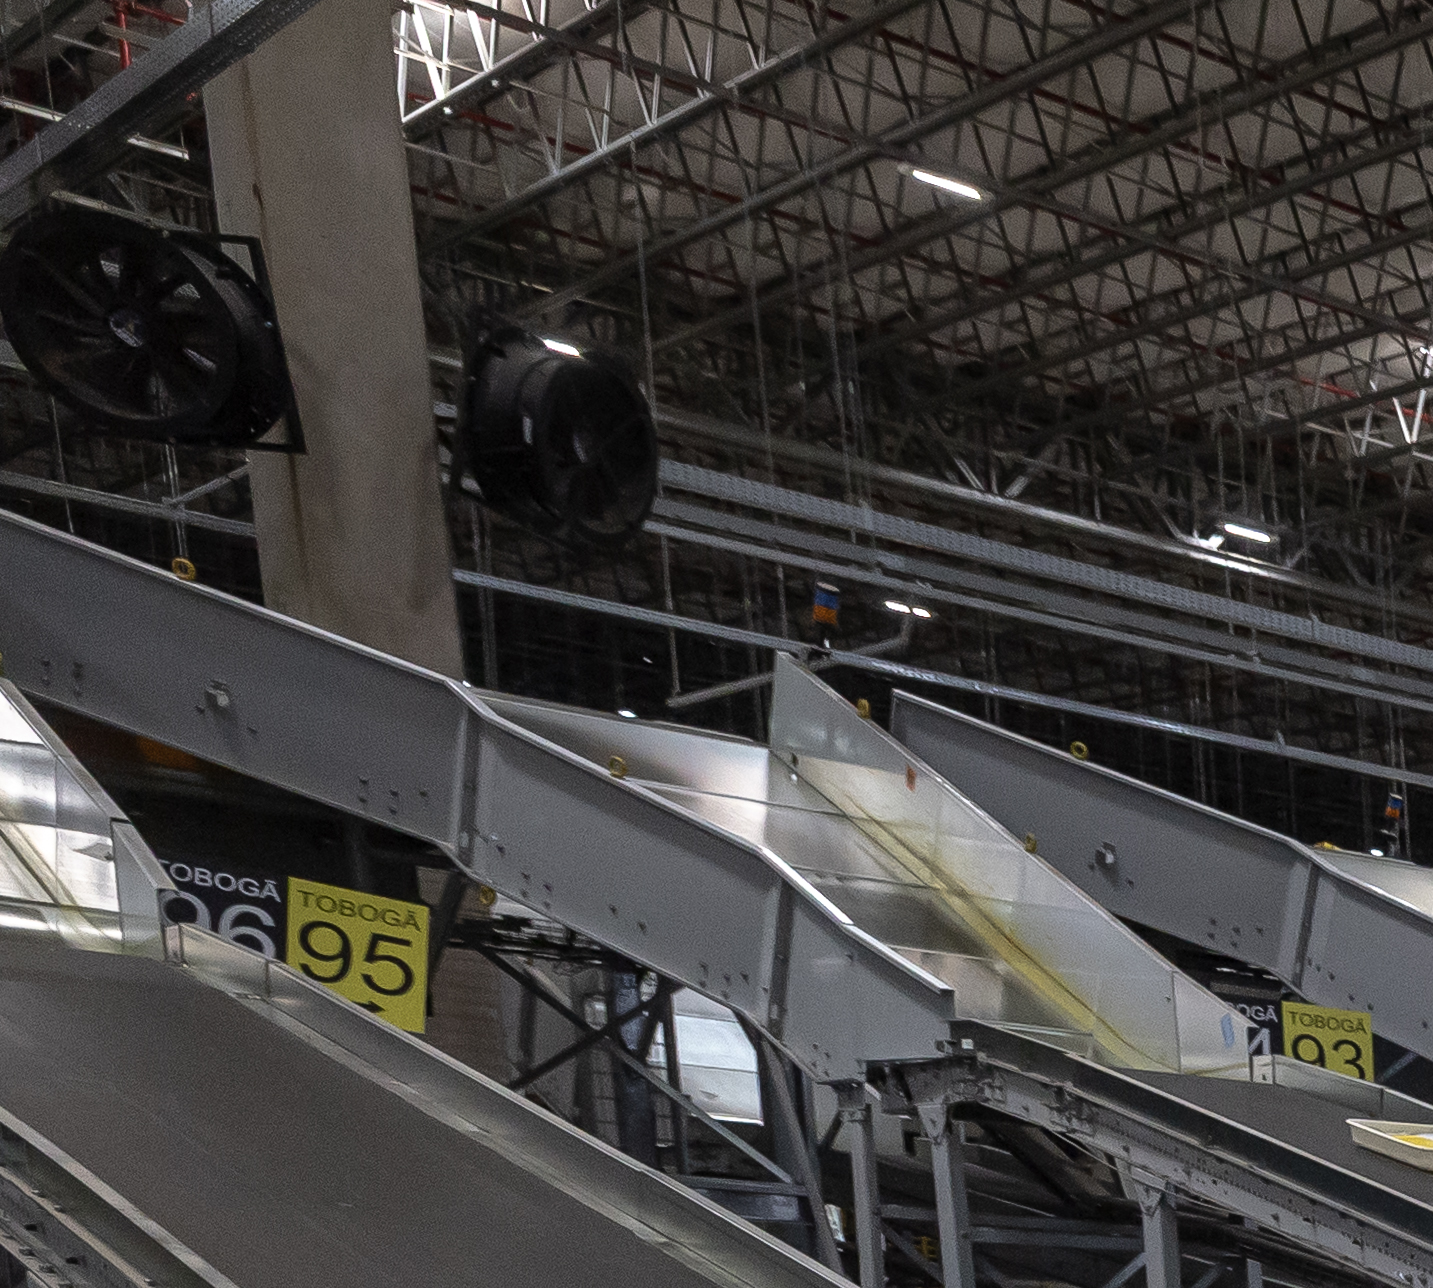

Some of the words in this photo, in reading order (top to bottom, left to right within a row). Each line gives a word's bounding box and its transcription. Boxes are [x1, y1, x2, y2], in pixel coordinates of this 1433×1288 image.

[297, 889, 421, 932] TOBOGÃ
[299, 920, 414, 996] 95
[1287, 1011, 1367, 1035] TOBOGÃ
[1291, 1033, 1366, 1080] 93
